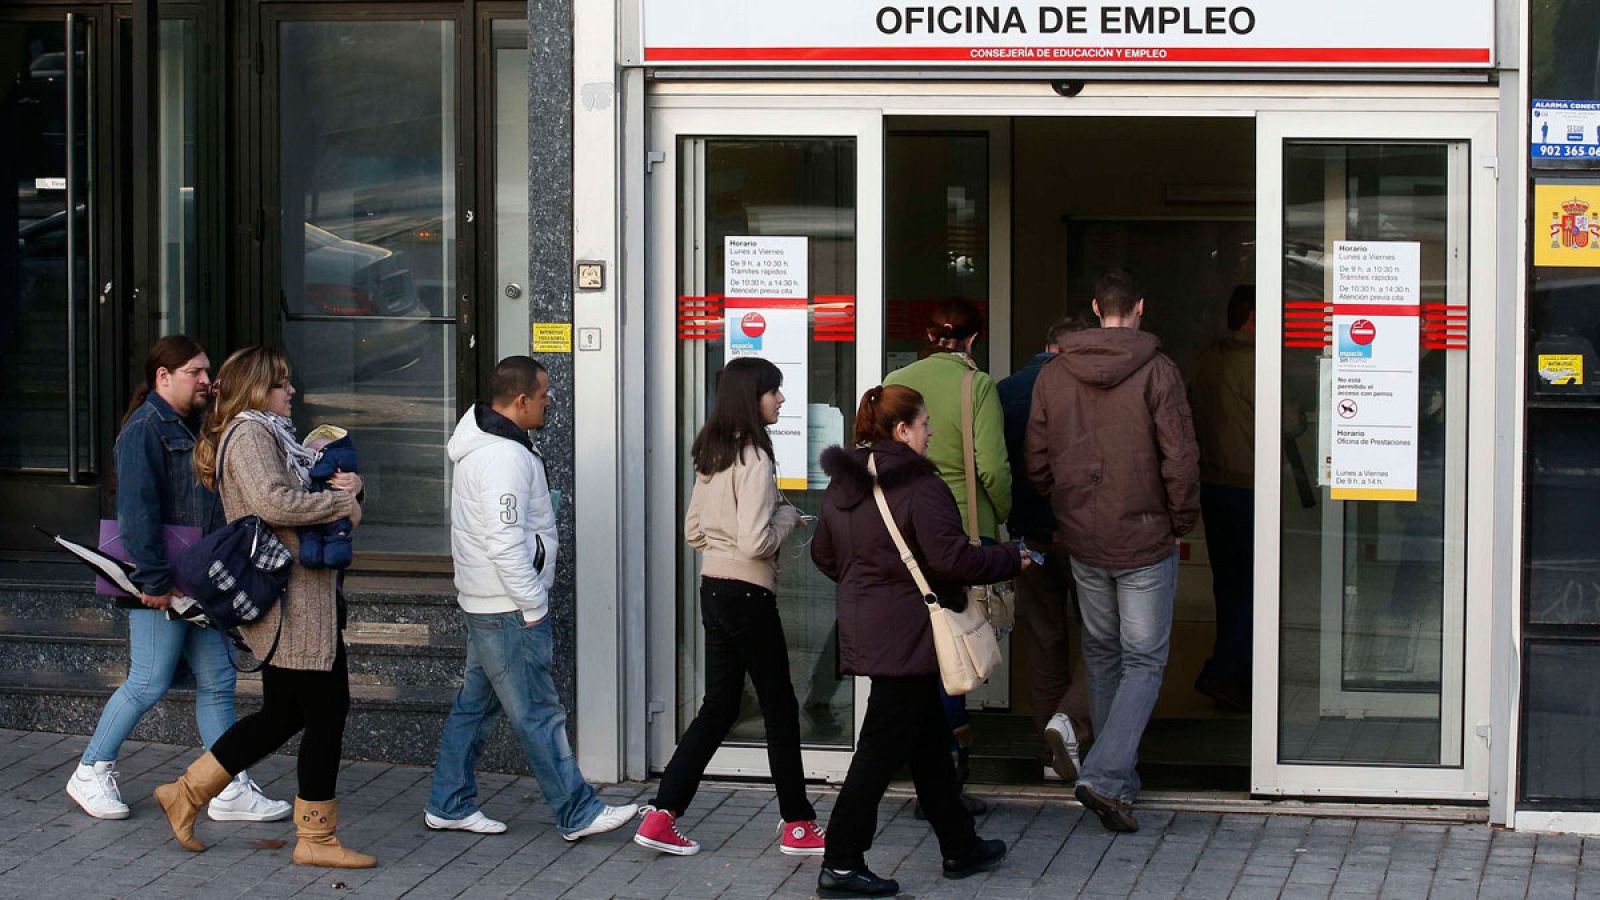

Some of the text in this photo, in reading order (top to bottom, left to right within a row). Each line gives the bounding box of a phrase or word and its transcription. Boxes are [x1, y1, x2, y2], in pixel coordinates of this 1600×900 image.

[876, 6, 1256, 35] OFICINA DE EMPLEO
[970, 47, 1167, 59] CONSEJERÍA DE EDUCACIÓN Y EMPLEO
[1540, 145, 1561, 156] 902
[1564, 146, 1585, 156] 365
[1339, 265, 1349, 273] De
[1351, 265, 1356, 273] 9
[1370, 438, 1411, 446] Prestaciones
[1335, 477, 1346, 485] De
[500, 493, 518, 525] 3
